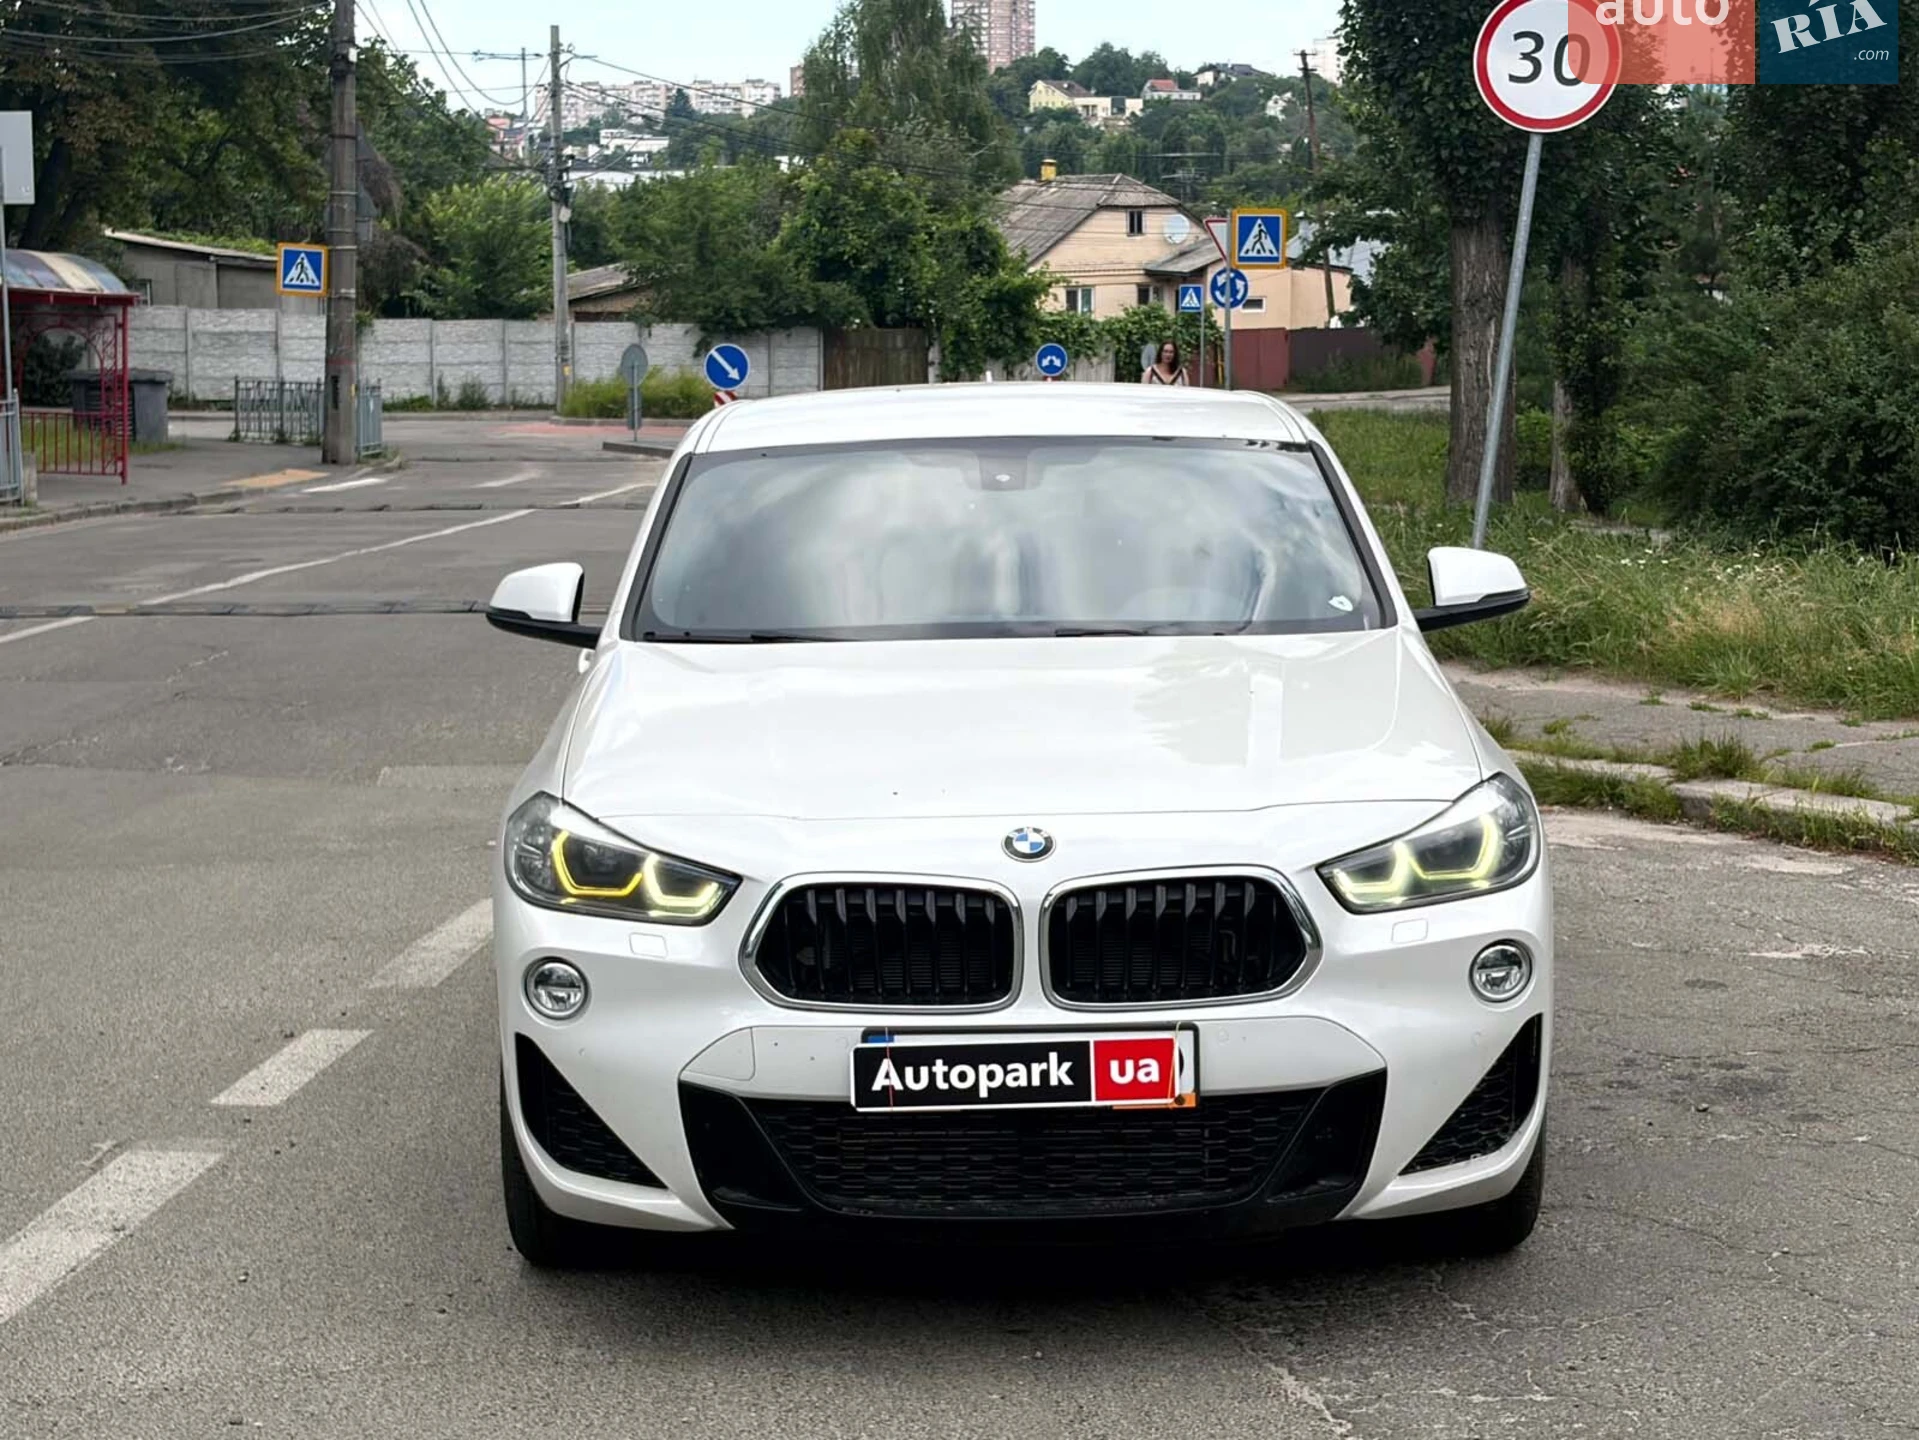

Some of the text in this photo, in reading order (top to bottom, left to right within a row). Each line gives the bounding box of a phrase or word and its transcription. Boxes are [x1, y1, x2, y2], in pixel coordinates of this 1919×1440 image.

[1507, 30, 1592, 87] 30
[871, 1052, 1074, 1098] Autopark
[1108, 1057, 1161, 1085] ua
